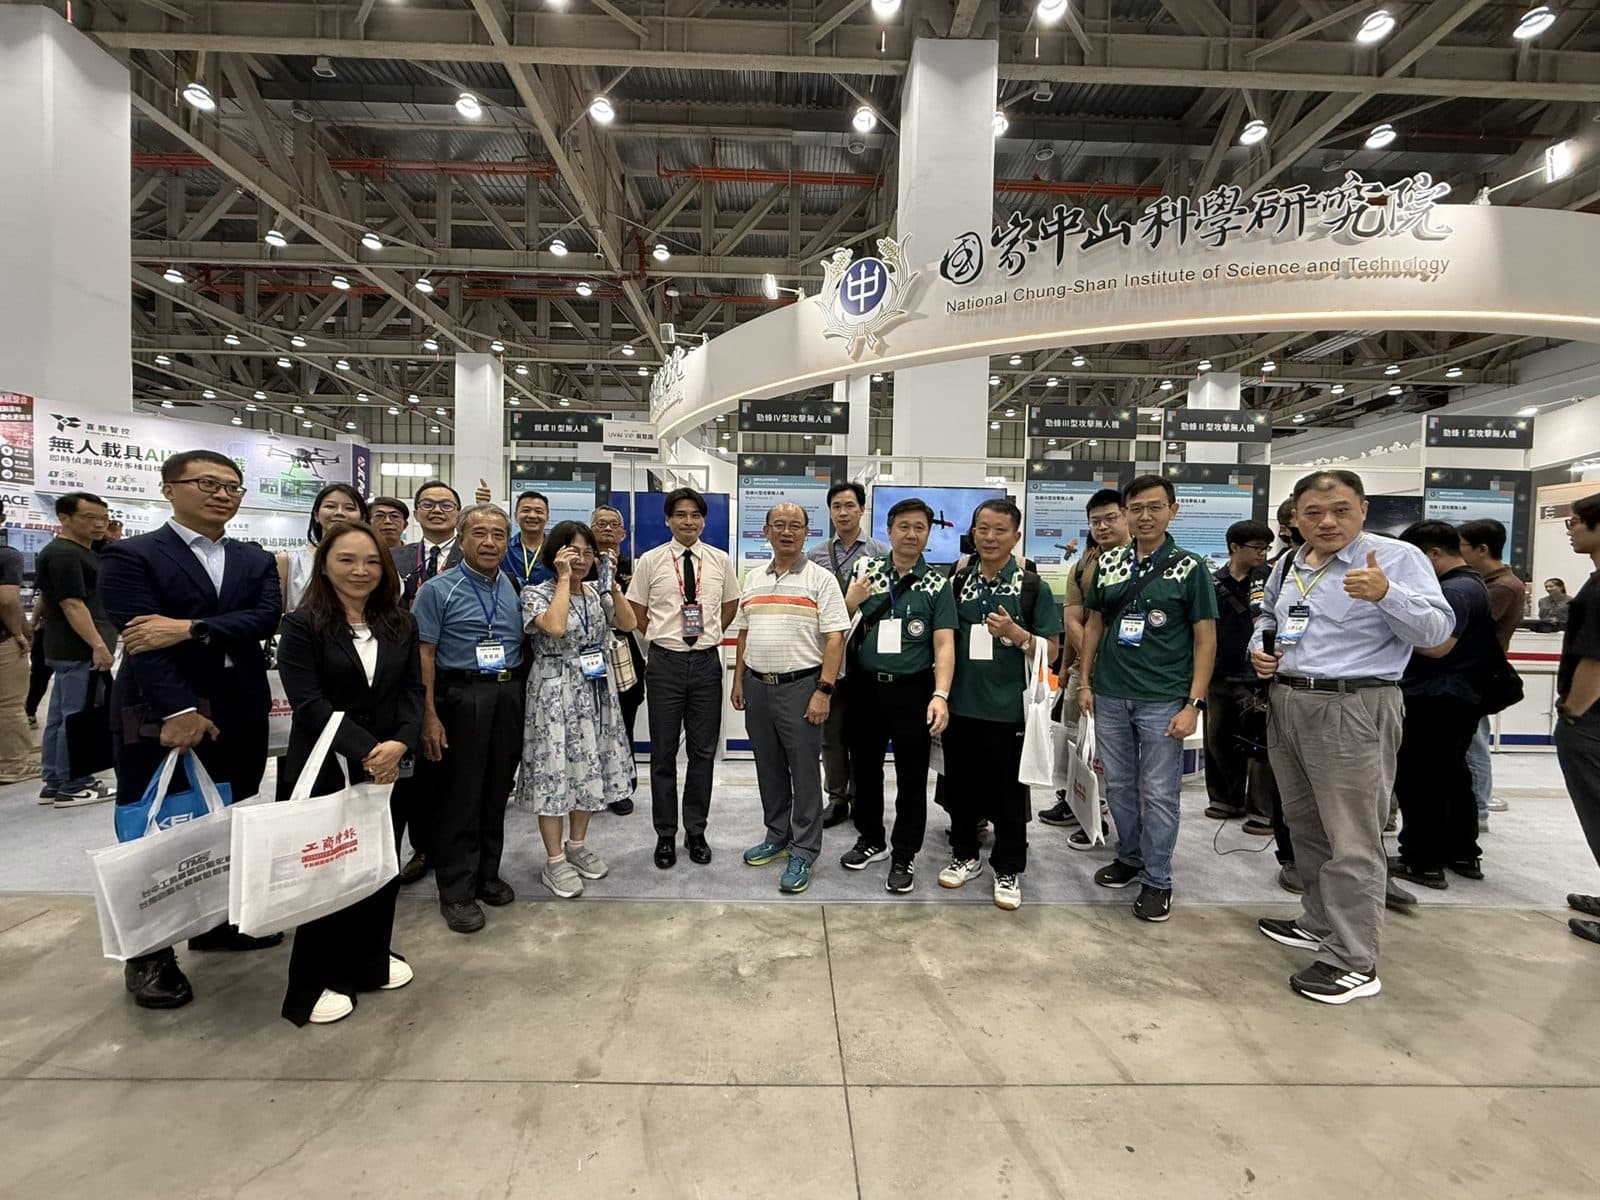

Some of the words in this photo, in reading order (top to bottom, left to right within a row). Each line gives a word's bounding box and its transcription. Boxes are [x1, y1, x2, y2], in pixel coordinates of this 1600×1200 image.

[940, 170, 1454, 286] 國家中山科學研究院
[946, 291, 1008, 313] National
[1013, 277, 1117, 303] Chung-Shan
[1123, 269, 1196, 289] Institute
[1202, 264, 1221, 281] of
[1226, 260, 1300, 278] Science
[1307, 257, 1341, 273] and
[1347, 255, 1450, 275] Technology
